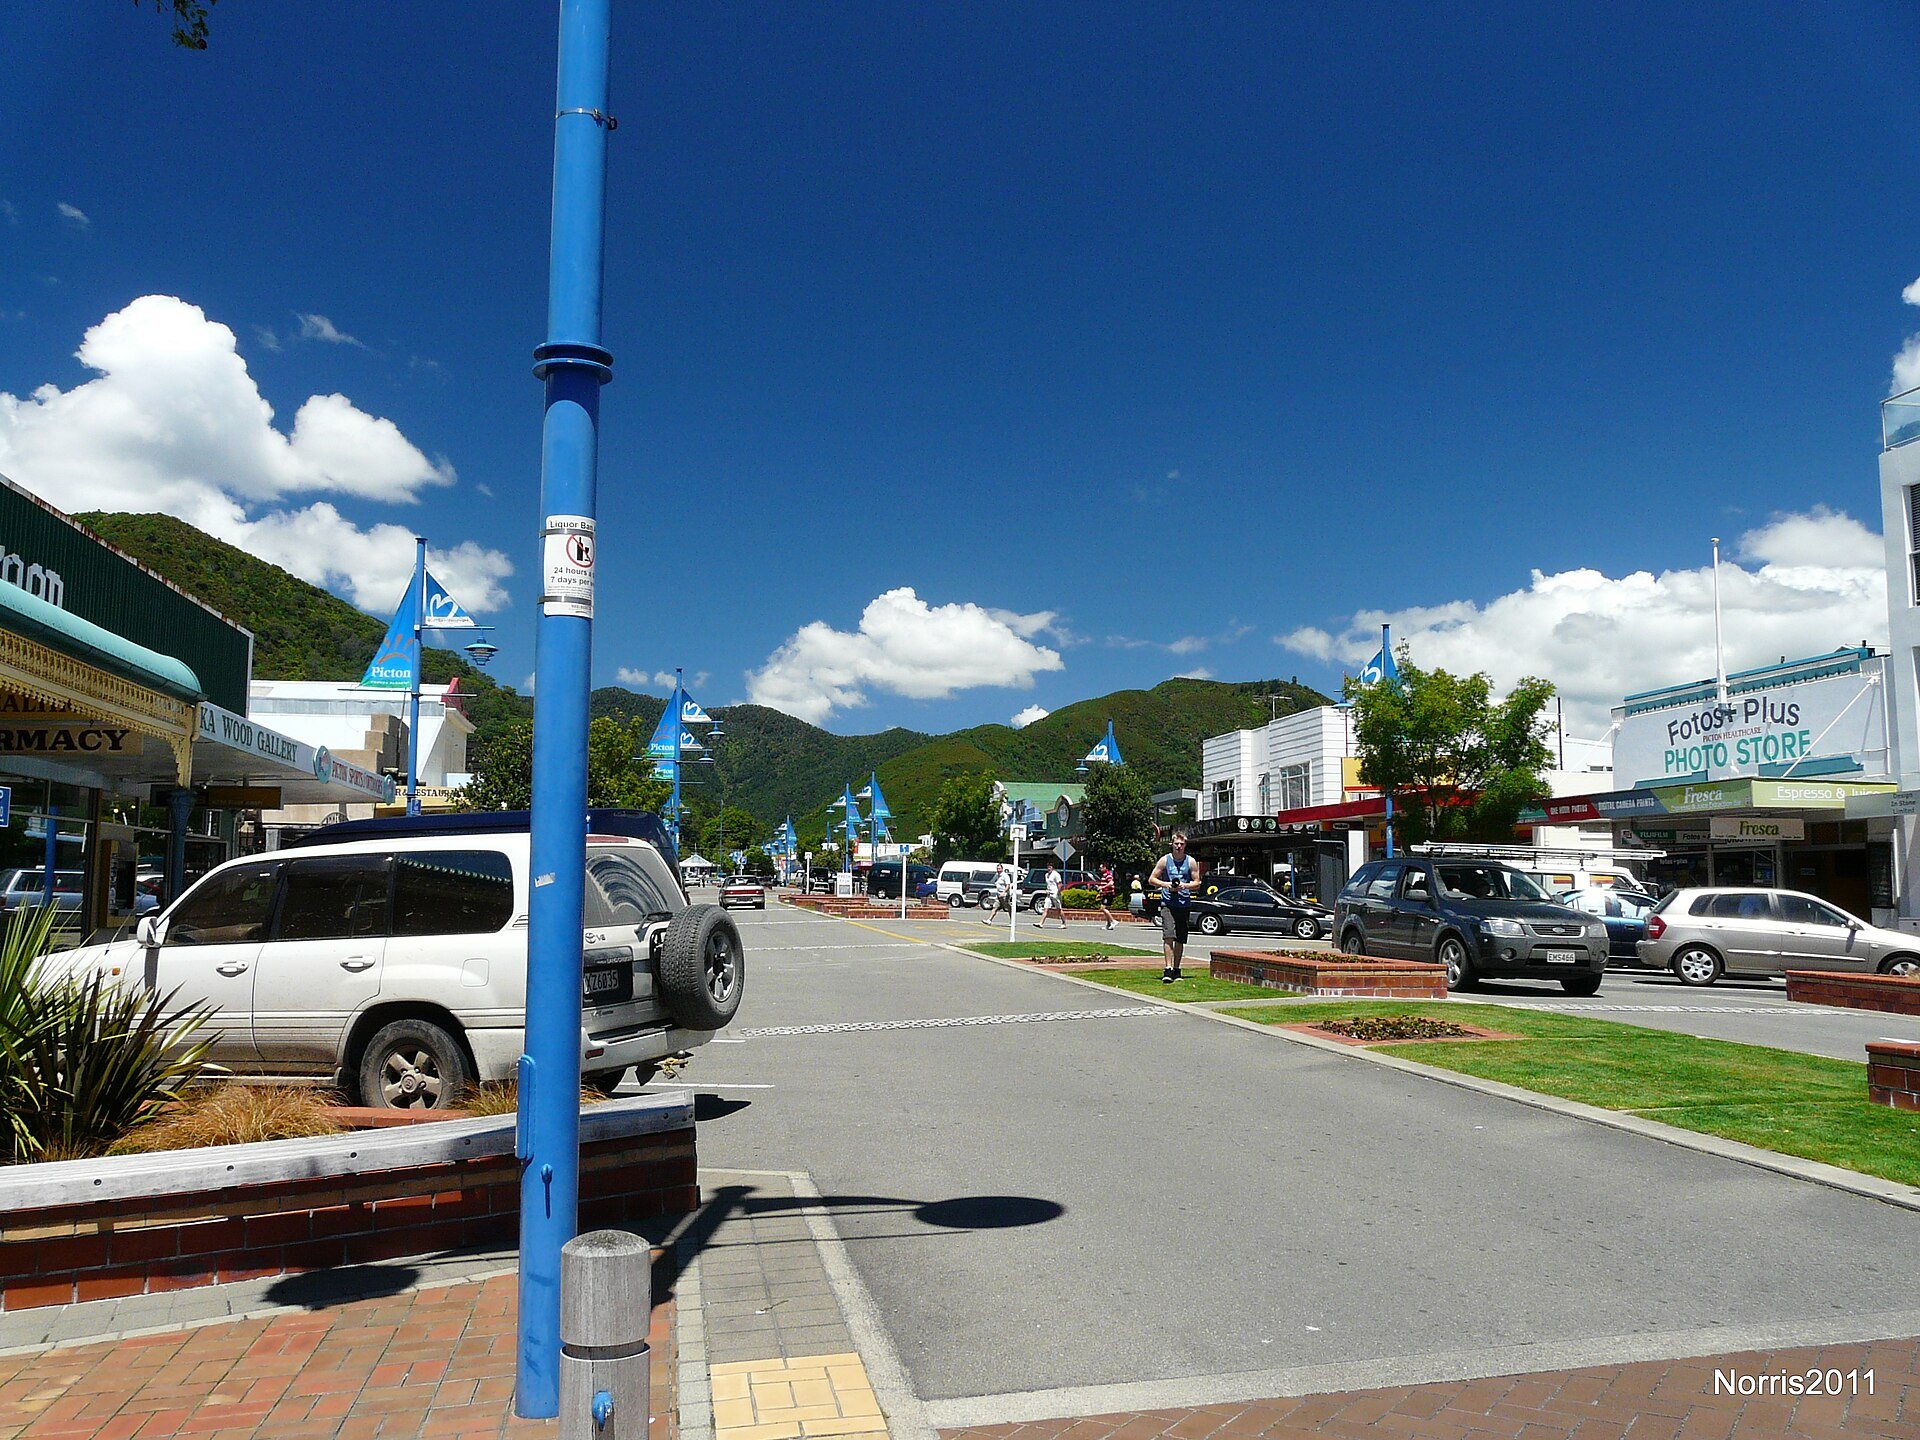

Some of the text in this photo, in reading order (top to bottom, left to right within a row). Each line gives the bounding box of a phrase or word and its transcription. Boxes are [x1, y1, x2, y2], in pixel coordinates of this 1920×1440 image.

[550, 520, 593, 530] Liquor Ban
[553, 566, 563, 574] 24
[565, 567, 587, 576] hours
[557, 576, 577, 585] days
[371, 666, 411, 678] Picton
[1744, 696, 1800, 727] Plus
[222, 714, 253, 747] WOOD
[257, 731, 298, 762] GALLERY
[1702, 726, 1762, 743] PICTON HEALTHCARE
[650, 743, 675, 751] Picton
[1664, 729, 1811, 773] PHOTO STORE
[1684, 786, 1722, 804] Fresca
[1777, 786, 1832, 801] Espresso
[1836, 788, 1846, 799] &
[1616, 799, 1636, 810] CAMERA
[1636, 797, 1655, 808] PRINTS
[1739, 820, 1779, 836] Fresca
[1548, 953, 1574, 962] EMS466
